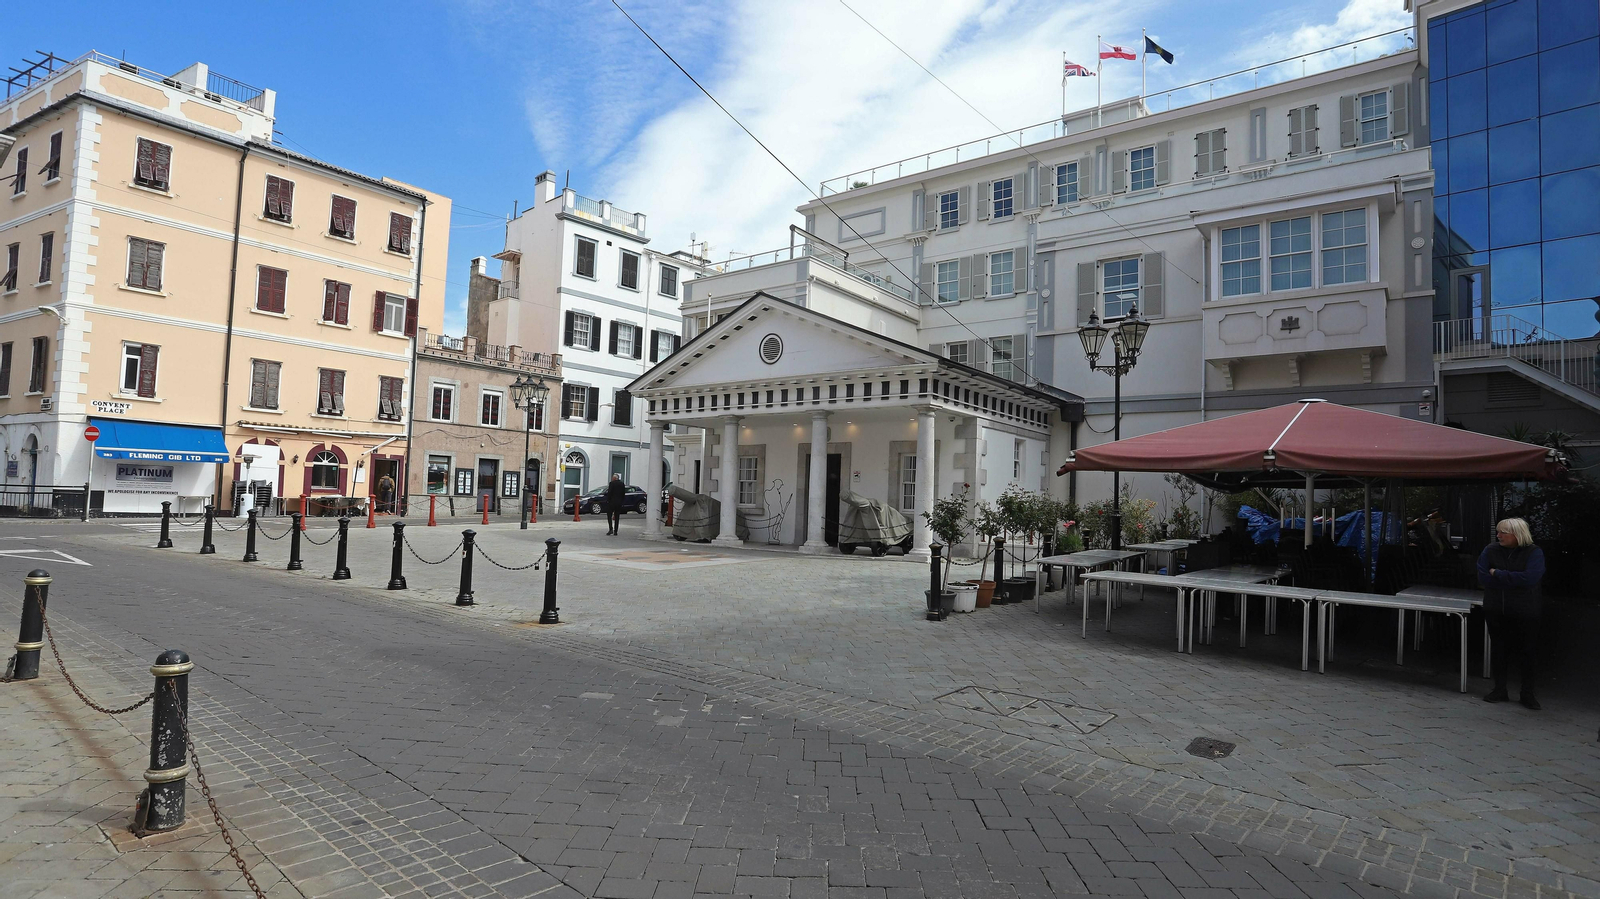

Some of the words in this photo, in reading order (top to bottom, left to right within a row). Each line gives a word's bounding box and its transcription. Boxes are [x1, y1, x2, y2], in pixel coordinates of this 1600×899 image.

[92, 400, 131, 409] CONVENT
[98, 406, 125, 414] PLACE
[129, 452, 164, 460] FLEMING
[118, 467, 172, 478] PLATINUM
